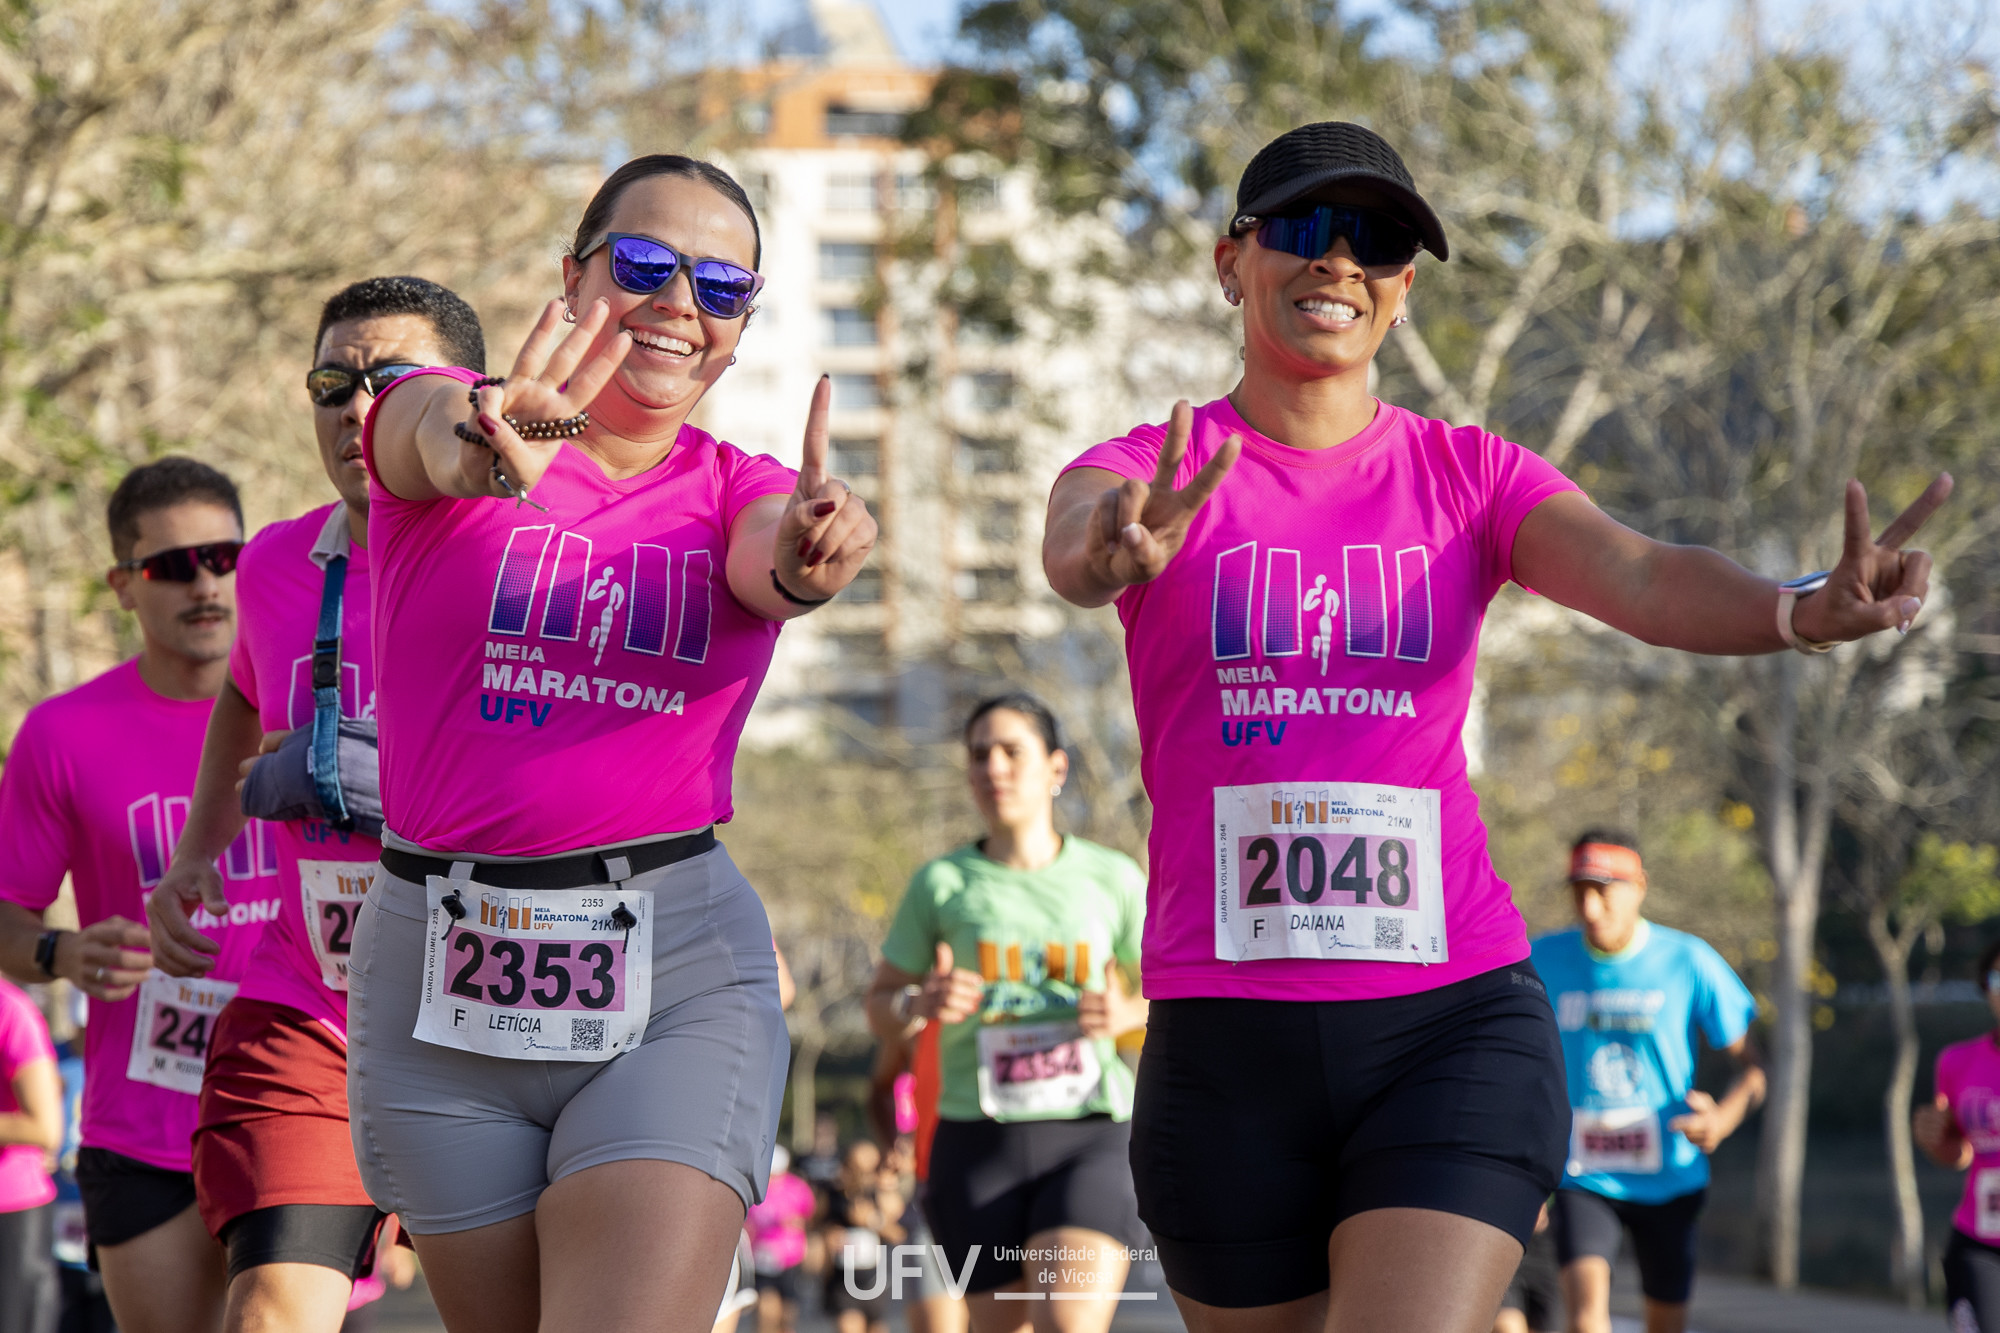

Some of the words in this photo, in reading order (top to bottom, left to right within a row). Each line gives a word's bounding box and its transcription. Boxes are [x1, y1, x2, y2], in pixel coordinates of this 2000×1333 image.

[484, 641, 546, 663] MEIA
[1216, 665, 1277, 684] MEIA
[482, 663, 685, 716] MARATONA
[479, 694, 552, 727] UFV
[1220, 687, 1417, 718] MARATONA
[1221, 720, 1288, 747] UFV
[1376, 793, 1397, 803] 2048
[1331, 807, 1385, 817] MARATONA
[1331, 816, 1352, 824] UFV
[1387, 815, 1412, 829] 21KM
[1246, 836, 1411, 907] 2048
[581, 898, 604, 908] 2353
[534, 914, 589, 922] MARATONA
[1253, 919, 1265, 939] F
[1290, 914, 1345, 931] DAIANA
[429, 930, 437, 969] VOLUMES
[1430, 936, 1438, 953] 2048
[449, 931, 616, 1009] 2353
[426, 970, 434, 1004] GUARDA
[454, 1009, 466, 1027] F
[488, 1012, 542, 1033] LETÍCIA
